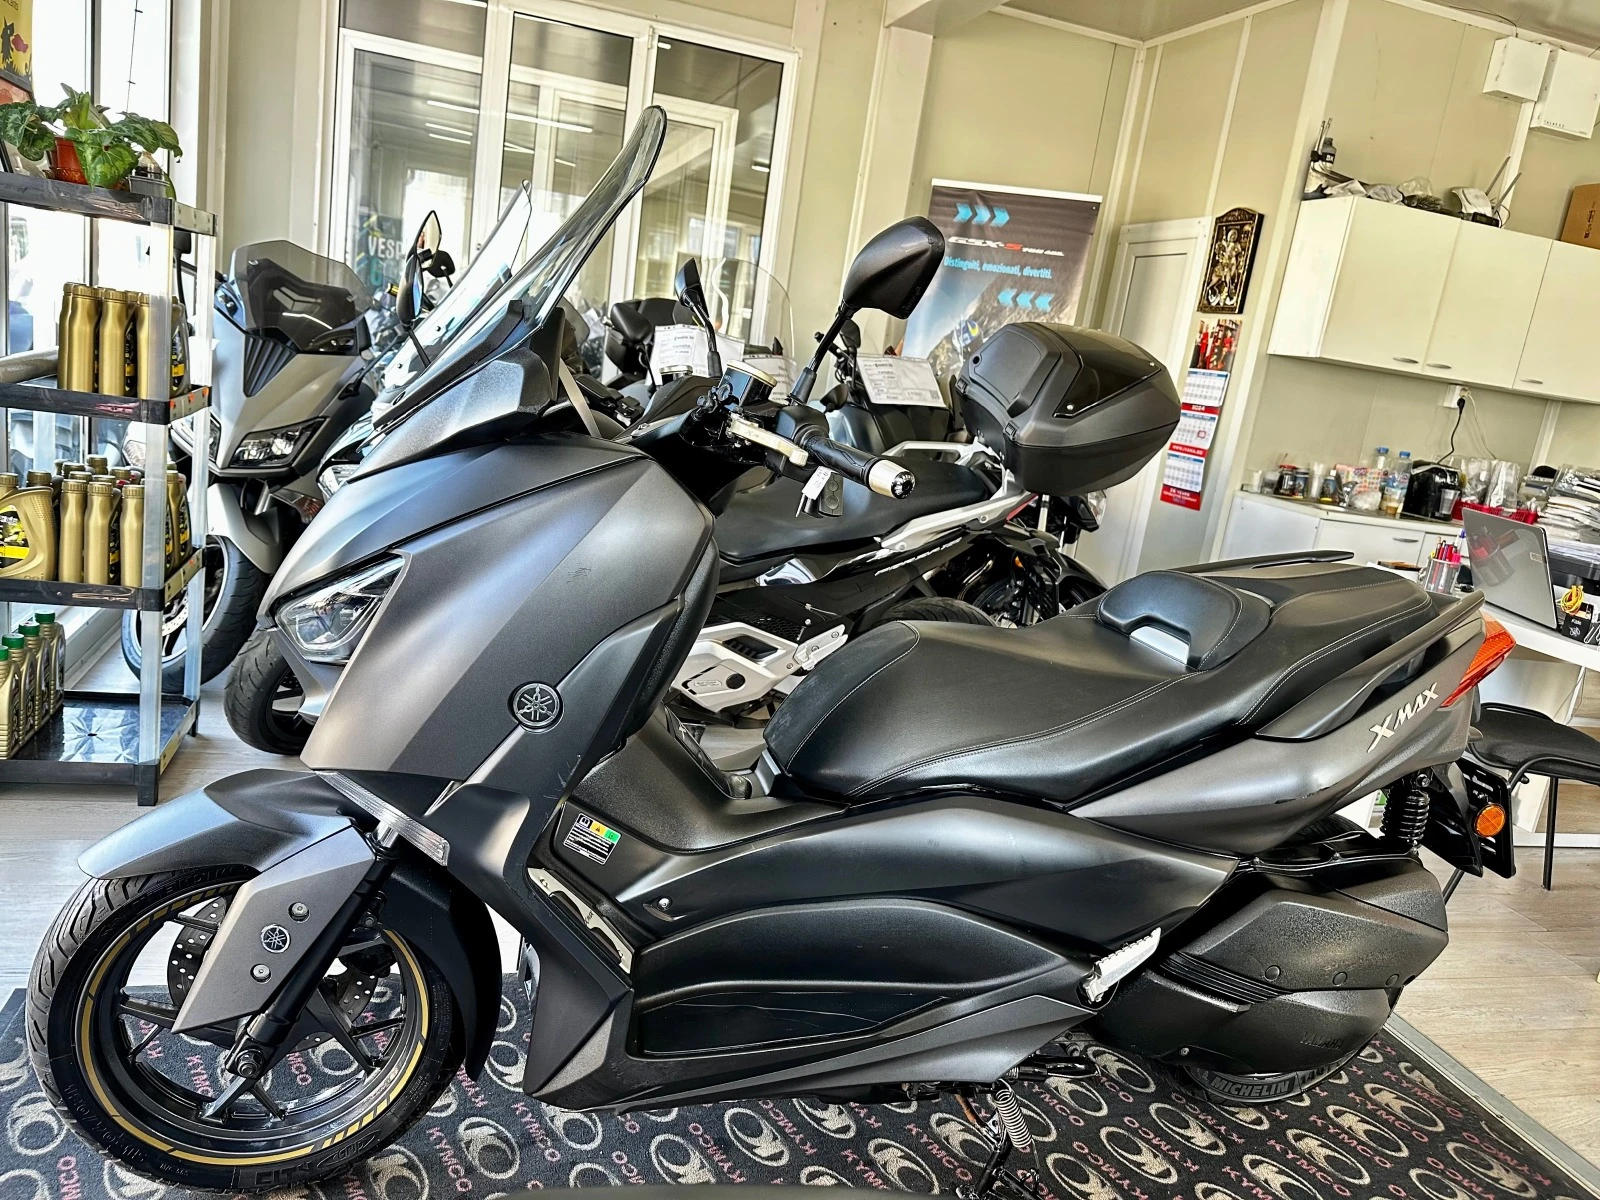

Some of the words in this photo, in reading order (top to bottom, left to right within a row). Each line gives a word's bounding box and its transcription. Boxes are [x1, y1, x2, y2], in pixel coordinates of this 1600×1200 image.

[944, 256, 981, 271] Distinguiti,
[982, 262, 1022, 276] emozionati,
[1023, 265, 1053, 279] divertiti.
[185, 1055, 215, 1099] KYMC
[286, 1051, 312, 1086] MCO
[1210, 1075, 1291, 1099] MICHELIN
[1383, 1070, 1464, 1119] KYMCO
[510, 1101, 561, 1162] KYMCO
[758, 1099, 817, 1156] KYMCO
[1123, 1116, 1200, 1173] KYMCO
[1171, 1092, 1246, 1145] KYMCO
[1308, 1114, 1393, 1169] KYMCO
[1347, 1091, 1429, 1143] KYMCO
[427, 1126, 473, 1192] KYMCO
[688, 1122, 747, 1184] KYMCO
[840, 1149, 890, 1190] KYM
[905, 1123, 973, 1181] KYMCO
[1072, 1141, 1149, 1200] KYMCO
[1266, 1138, 1353, 1197] KYMCO
[1461, 1131, 1552, 1187] KYMCO
